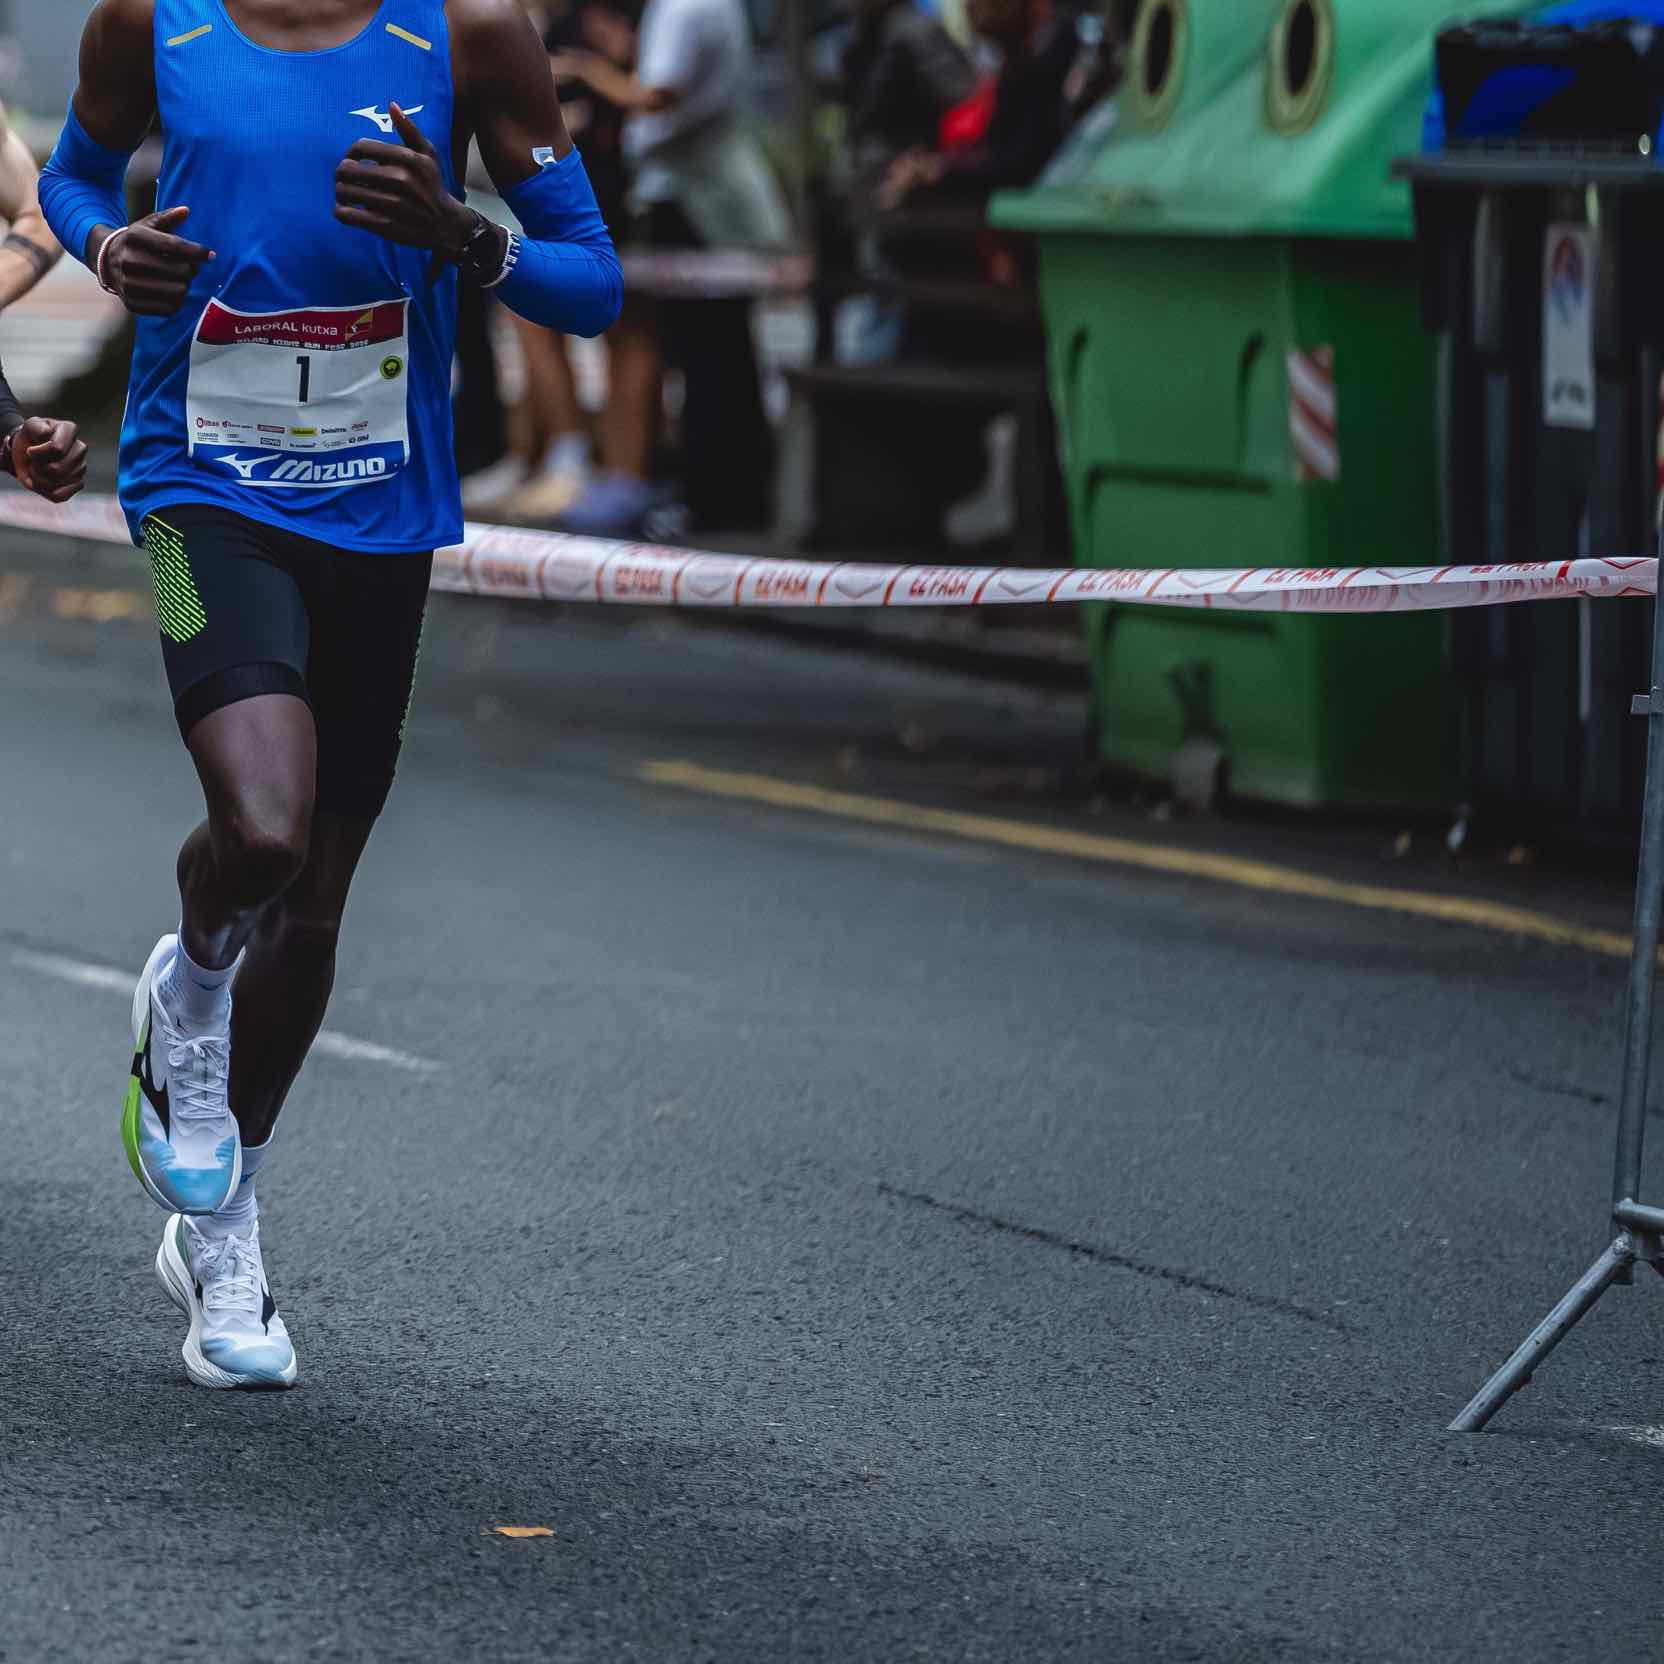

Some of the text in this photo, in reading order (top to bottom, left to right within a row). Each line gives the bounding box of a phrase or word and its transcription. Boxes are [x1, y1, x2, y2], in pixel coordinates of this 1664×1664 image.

[235, 321, 338, 336] LABORAL kutxa
[296, 355, 310, 403] 1
